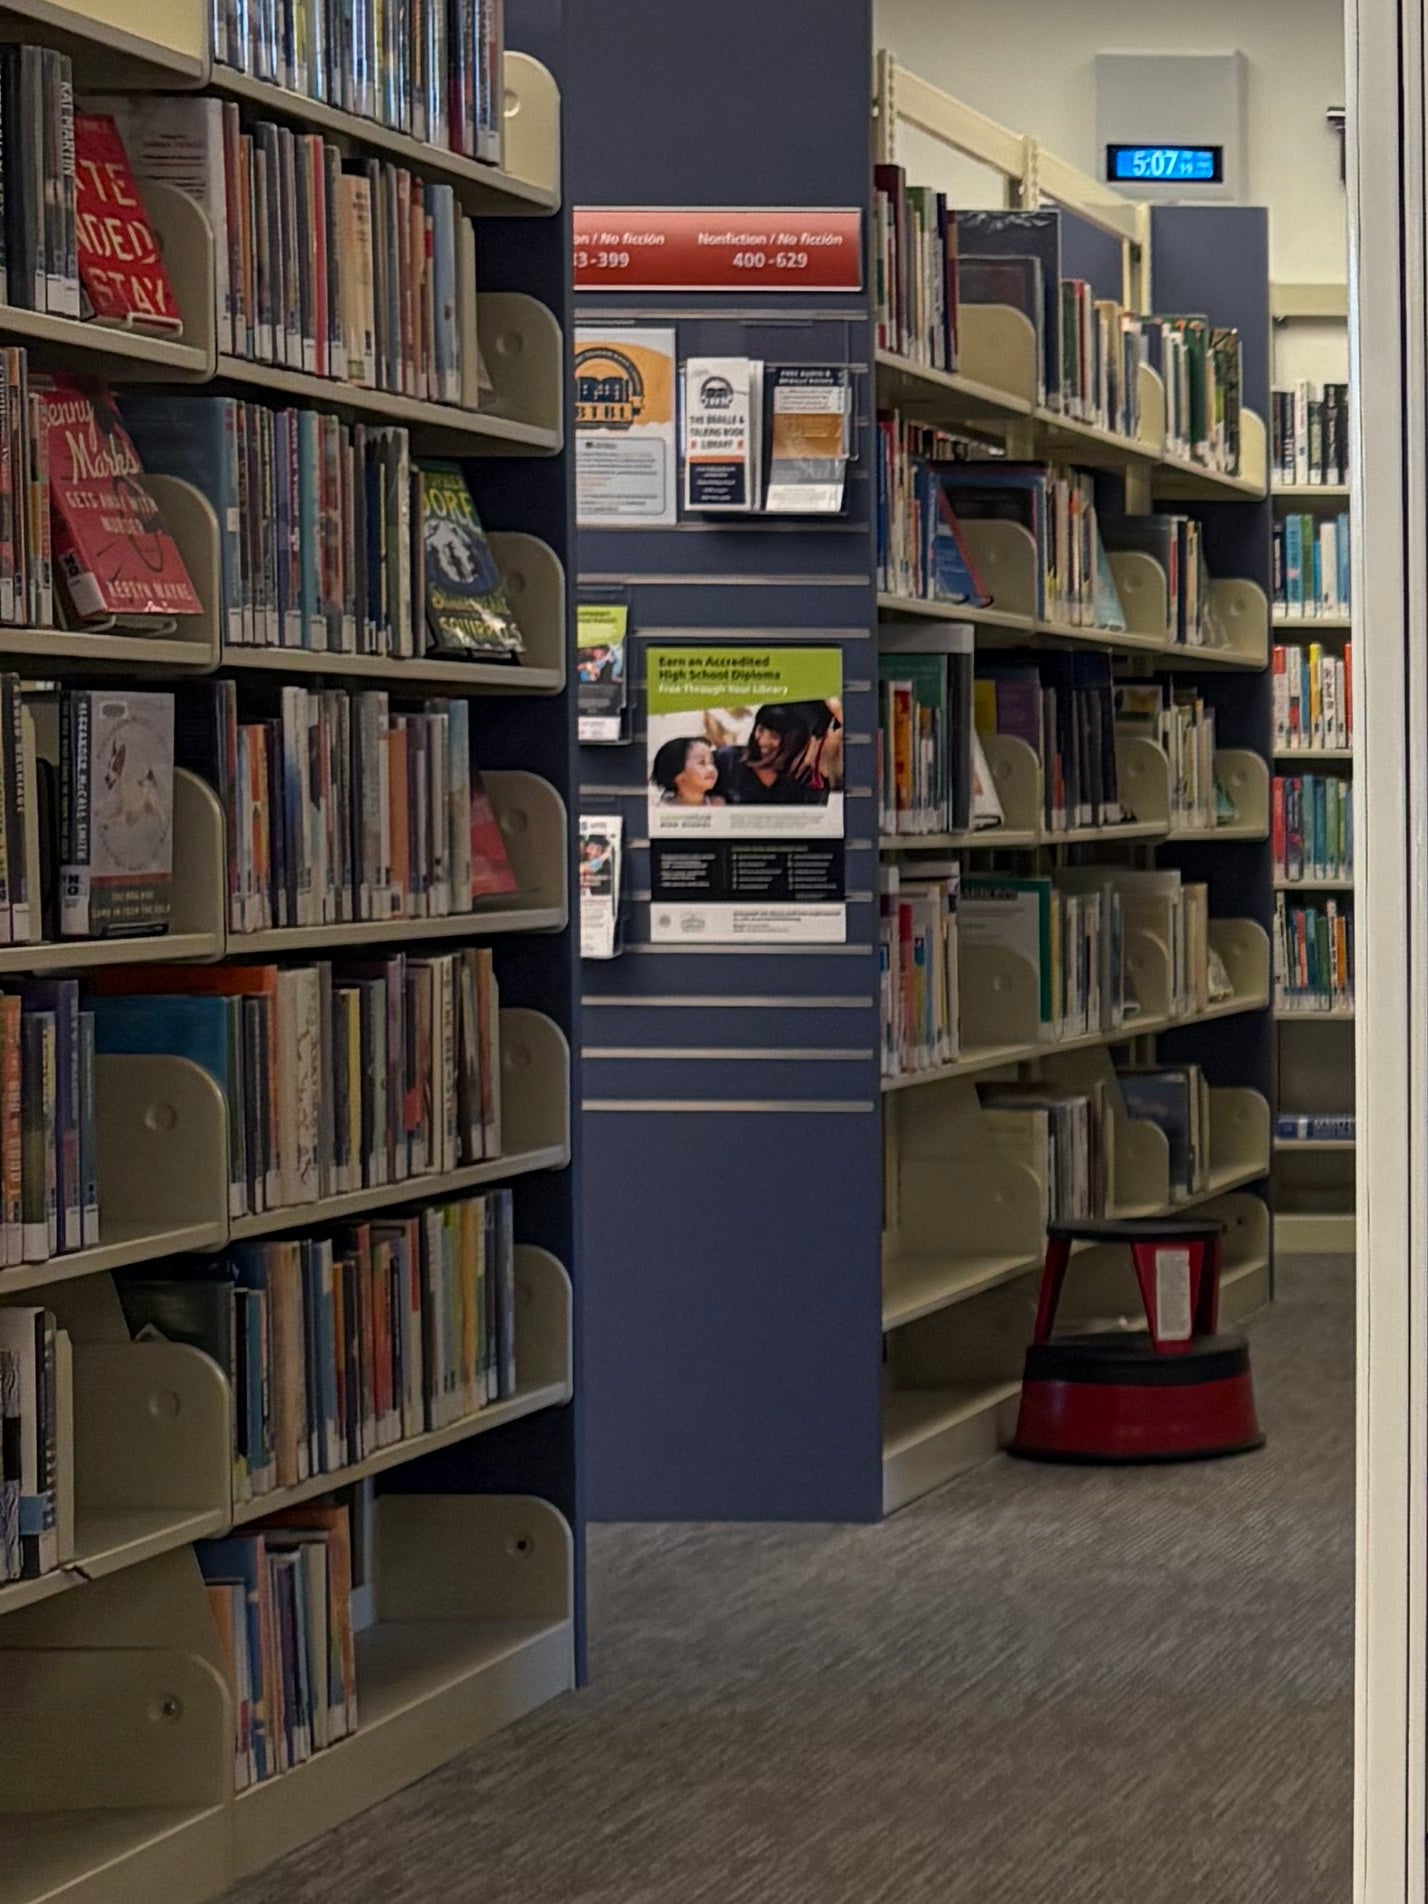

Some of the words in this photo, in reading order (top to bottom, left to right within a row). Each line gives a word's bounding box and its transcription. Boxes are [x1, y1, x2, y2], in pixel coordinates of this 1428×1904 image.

[87, 266, 168, 315] STAY
[65, 429, 141, 486] Marks
[658, 656, 686, 667] Earn
[687, 657, 704, 667] an
[705, 656, 771, 667] Accredited
[658, 669, 686, 682] High
[688, 669, 729, 681] School
[731, 669, 782, 682] Diploma
